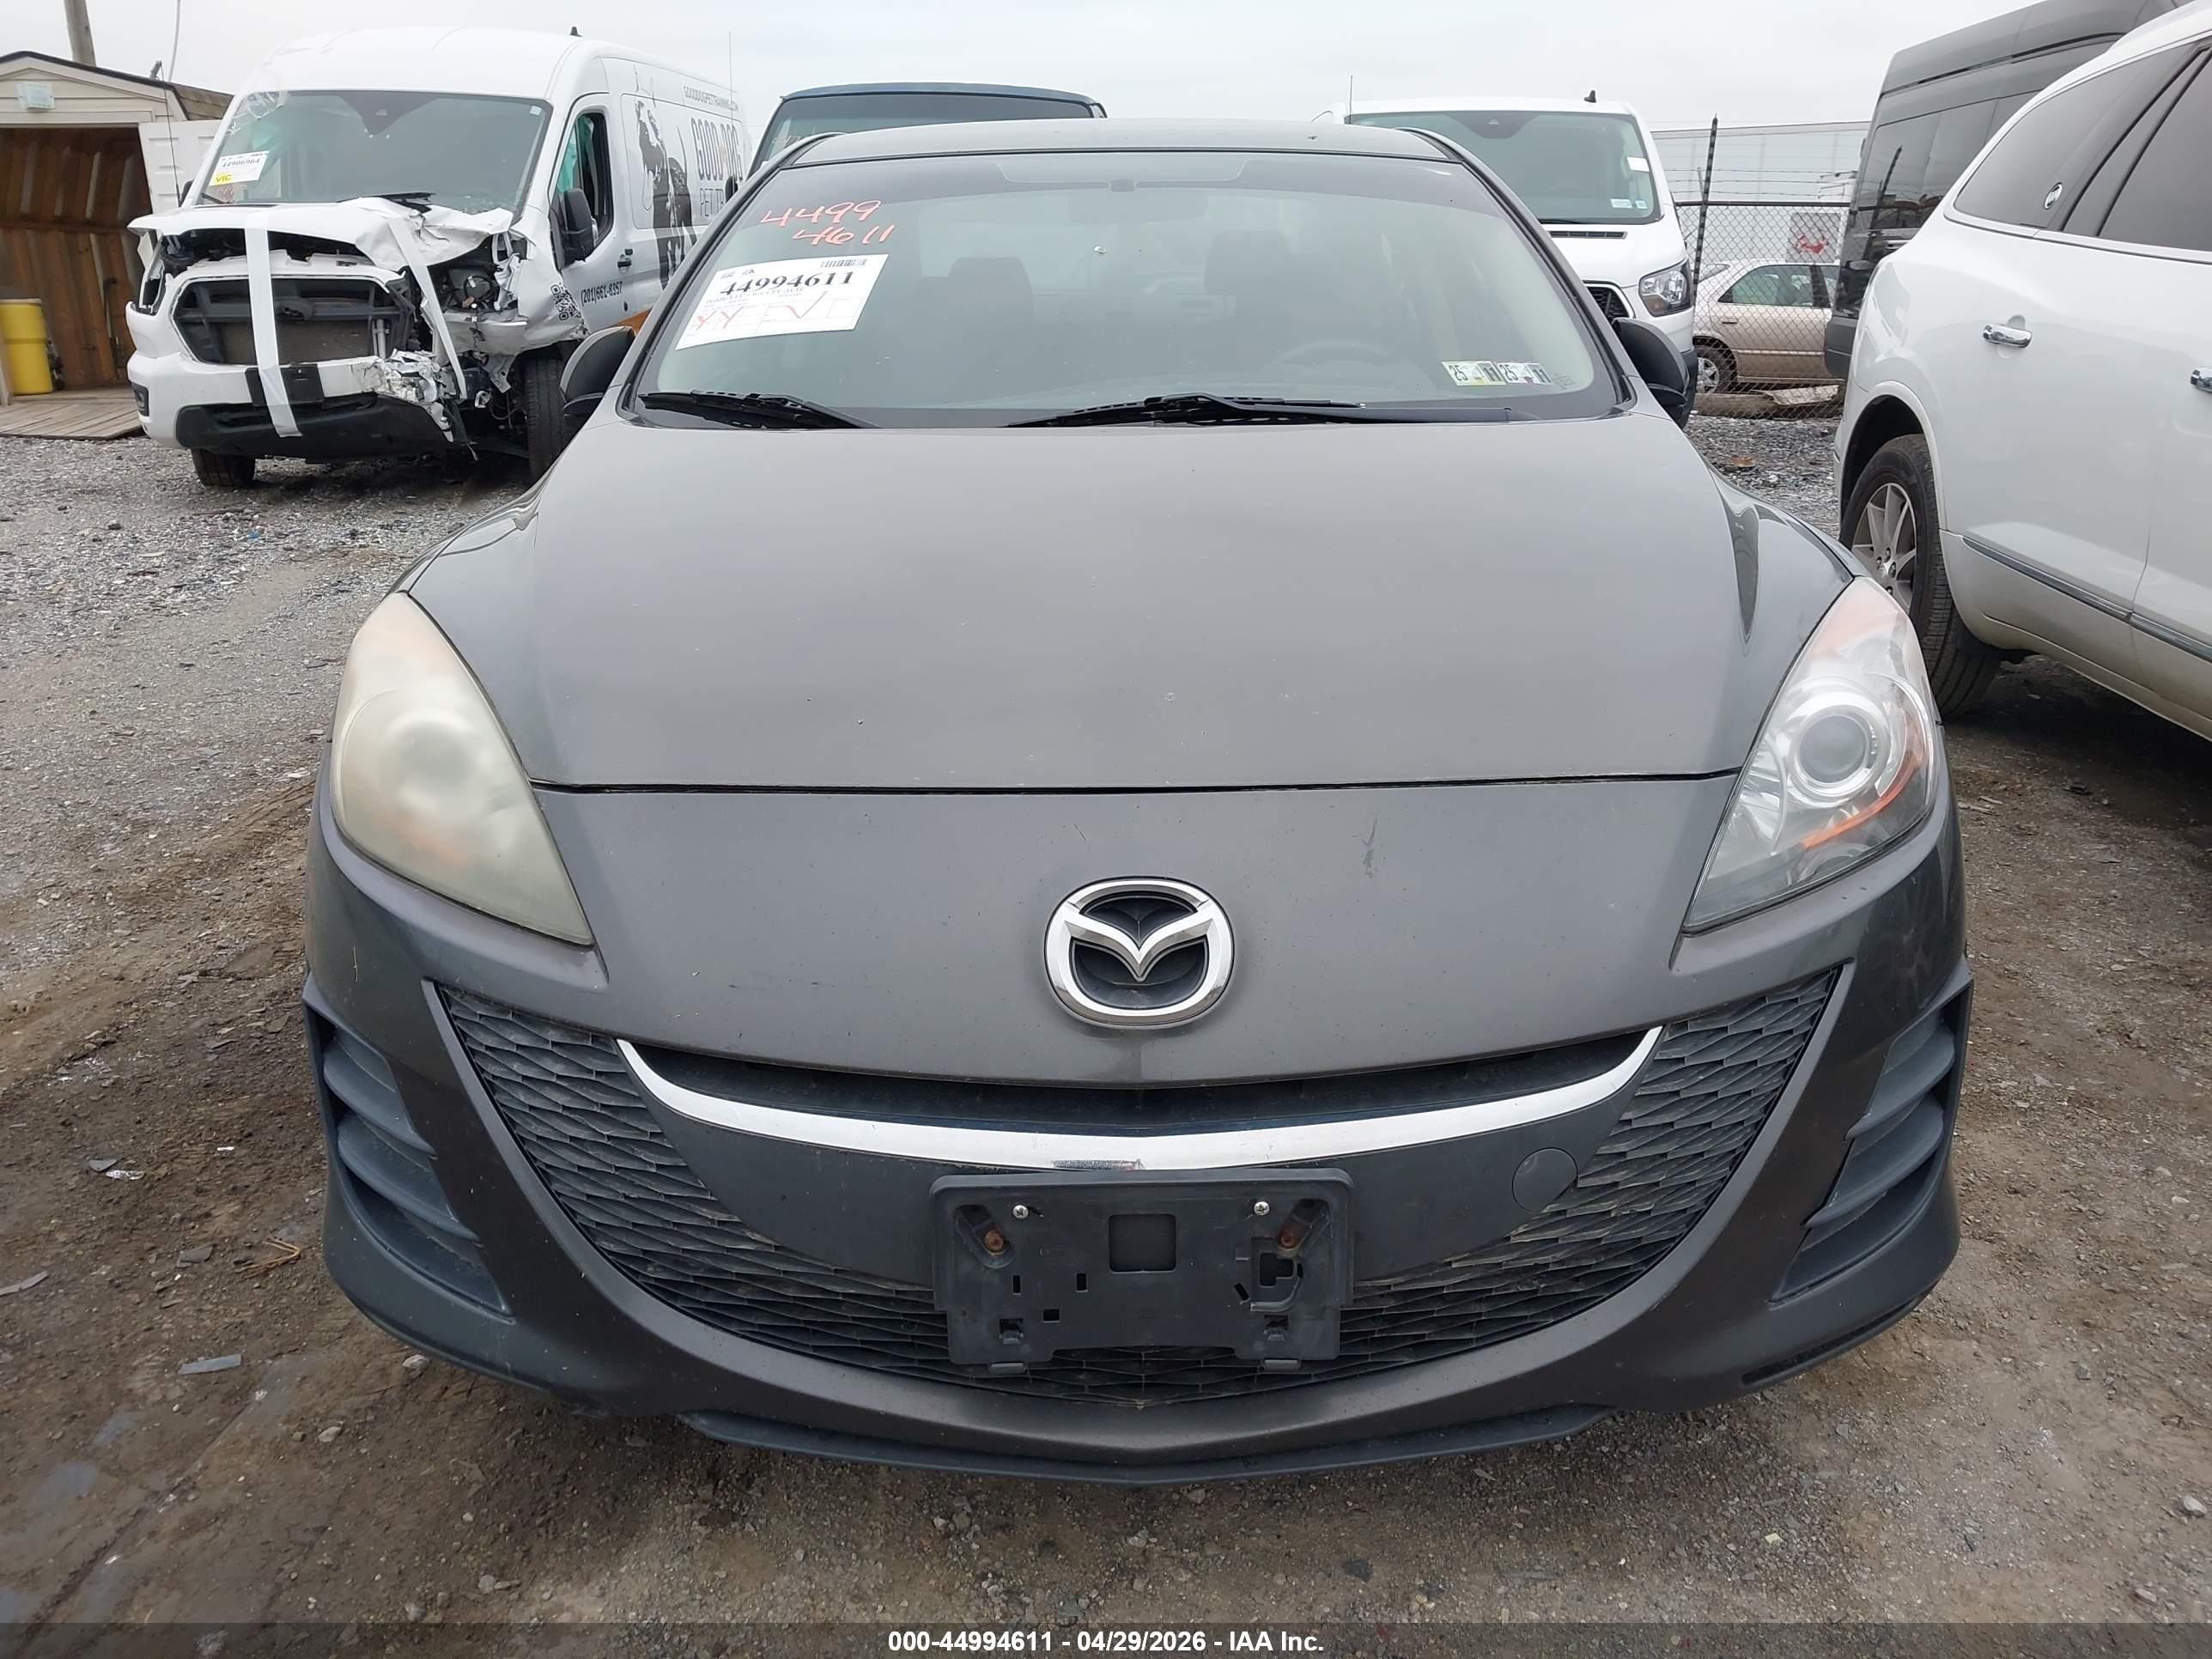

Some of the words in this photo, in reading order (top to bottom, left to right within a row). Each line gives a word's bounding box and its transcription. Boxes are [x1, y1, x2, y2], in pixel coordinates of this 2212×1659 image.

[691, 117, 723, 181] GOOD
[216, 174, 232, 183] VIC
[761, 200, 882, 227] 4499
[792, 224, 895, 246] 4611
[720, 270, 854, 295] 44994611
[1449, 364, 1468, 381] 25
[1499, 364, 1518, 381] 25
